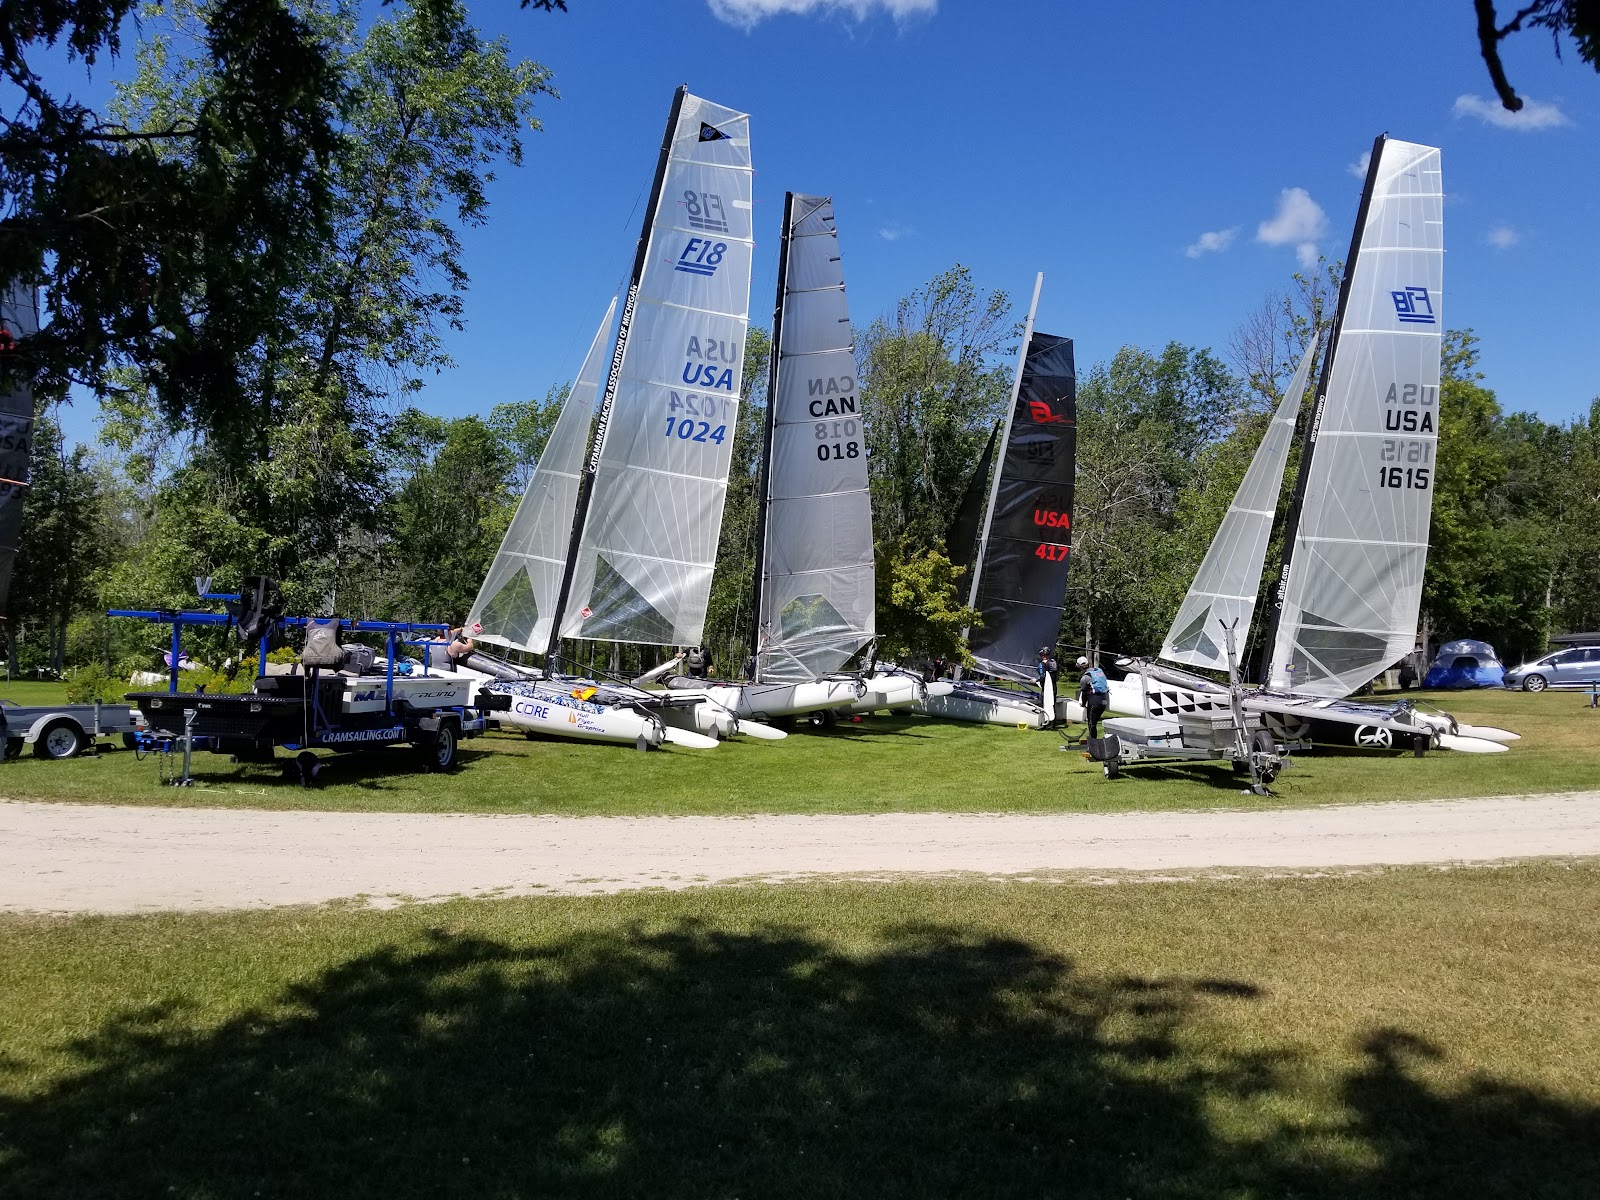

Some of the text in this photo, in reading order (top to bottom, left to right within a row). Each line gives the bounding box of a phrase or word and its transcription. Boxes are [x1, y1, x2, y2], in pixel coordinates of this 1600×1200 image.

[680, 238, 727, 265] F18
[590, 284, 637, 473] CATAMARAN RACING ASSOCIATION OF MICHIGAN
[682, 362, 733, 391] USA
[809, 396, 856, 417] CAN
[665, 417, 726, 444] 1024
[1386, 410, 1433, 432] USA
[0, 435, 28, 453] SA
[817, 442, 860, 461] 018
[1380, 467, 1430, 489] 1615
[1034, 510, 1070, 529] USA
[1035, 543, 1069, 562] 417
[1277, 564, 1290, 600] altair.com
[409, 690, 456, 699] racing
[515, 702, 550, 719] CORE
[322, 730, 400, 742] CRAMSAILING.COM
